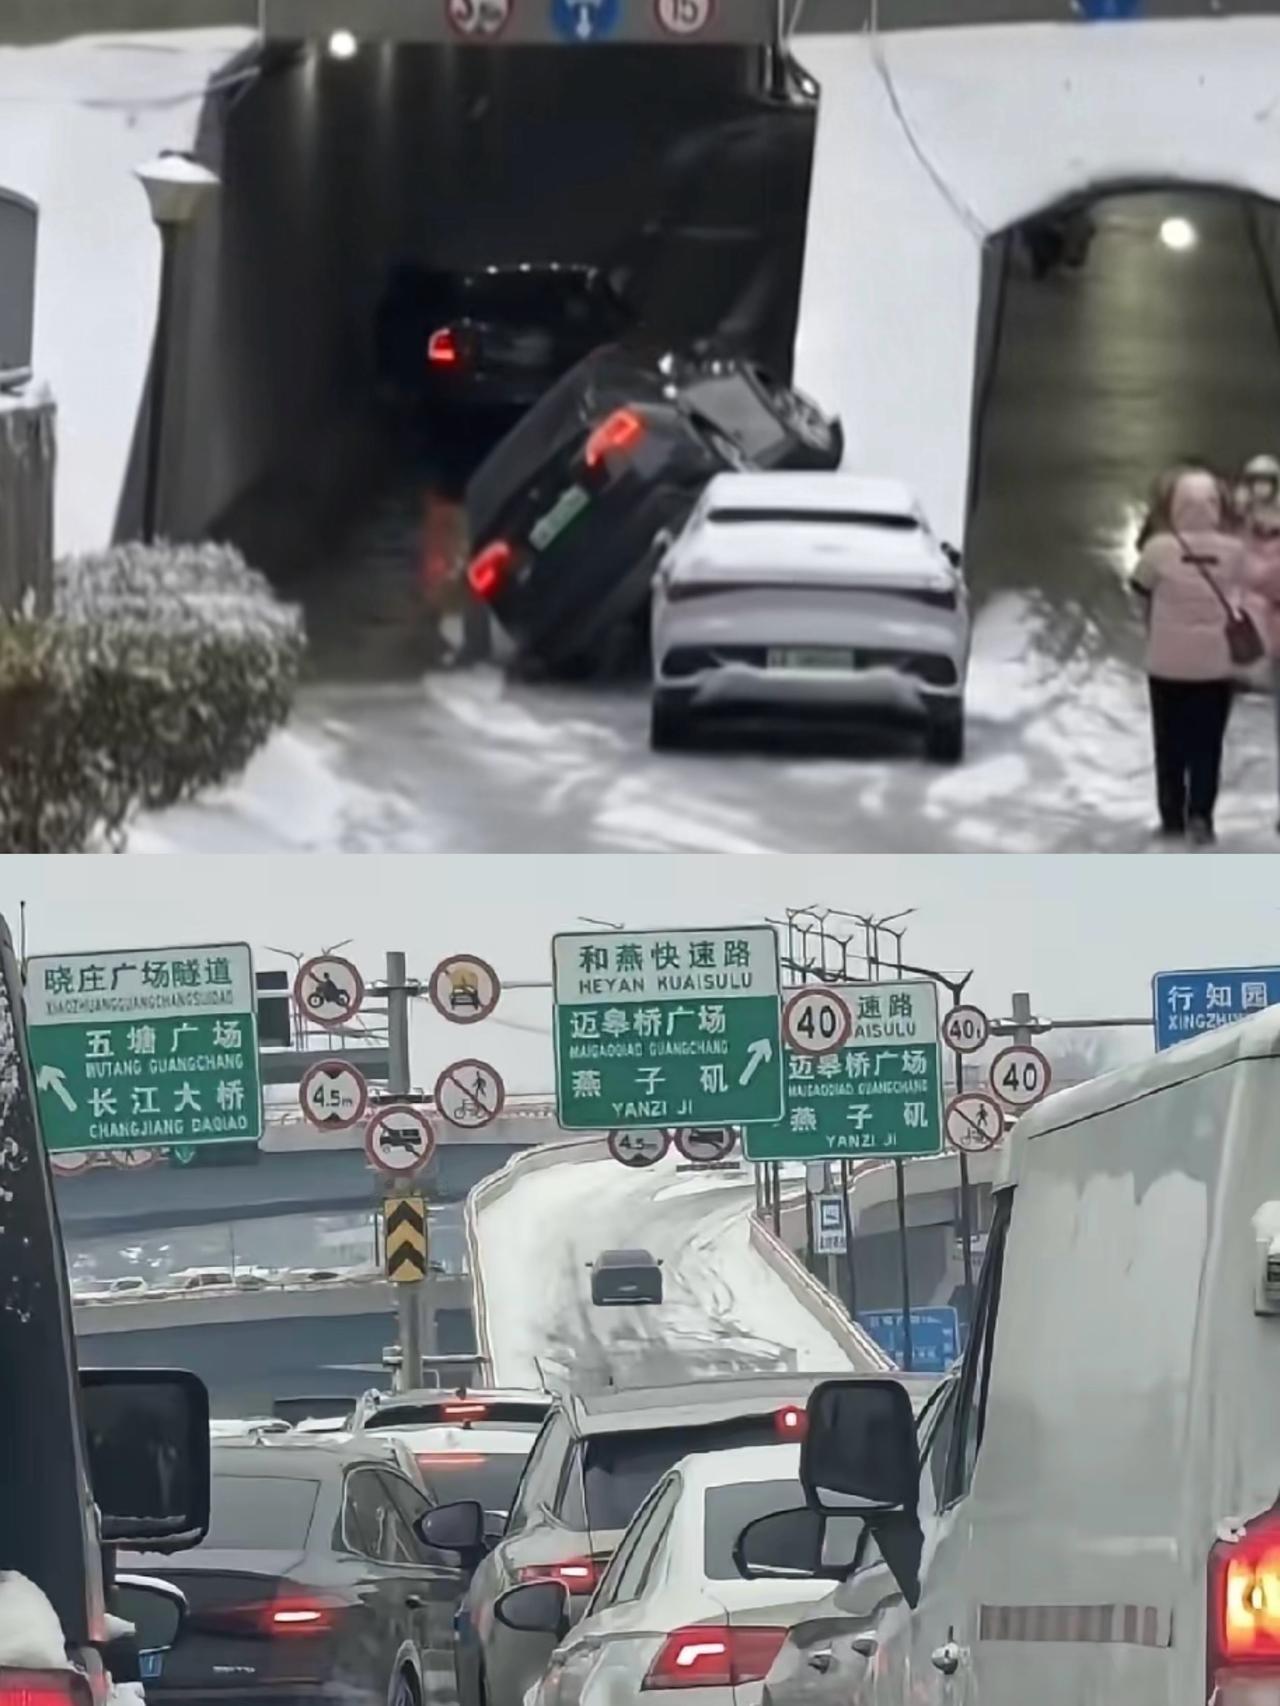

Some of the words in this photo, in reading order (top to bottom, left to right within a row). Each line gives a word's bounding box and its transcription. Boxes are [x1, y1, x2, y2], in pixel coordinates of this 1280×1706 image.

[579, 940, 751, 974] 和燕快速路
[44, 957, 233, 995] 晓庄广场隧道
[579, 978, 645, 995] HEYAN
[657, 973, 752, 991] KUAISULU
[1167, 982, 1268, 1013] 行知园
[569, 1004, 727, 1038] 迈皋桥广场
[796, 1004, 837, 1040] 40
[854, 1021, 917, 1039] AISULU
[85, 1020, 242, 1058] 五塘广场
[85, 1061, 142, 1079] WUTANG
[150, 1053, 244, 1073] GUANGCHANG
[571, 1064, 729, 1098] 燕子矶
[1002, 1062, 1038, 1092] 40
[87, 1079, 245, 1118] 长江大桥
[612, 1101, 667, 1119] YANZI
[677, 1100, 693, 1115] JI
[89, 1119, 184, 1139] CHANGJIANG
[192, 1115, 248, 1132] DAQIAO
[790, 1102, 929, 1132] 燕子矶
[825, 1134, 877, 1149] YANZI
[884, 1133, 898, 1147] JI
